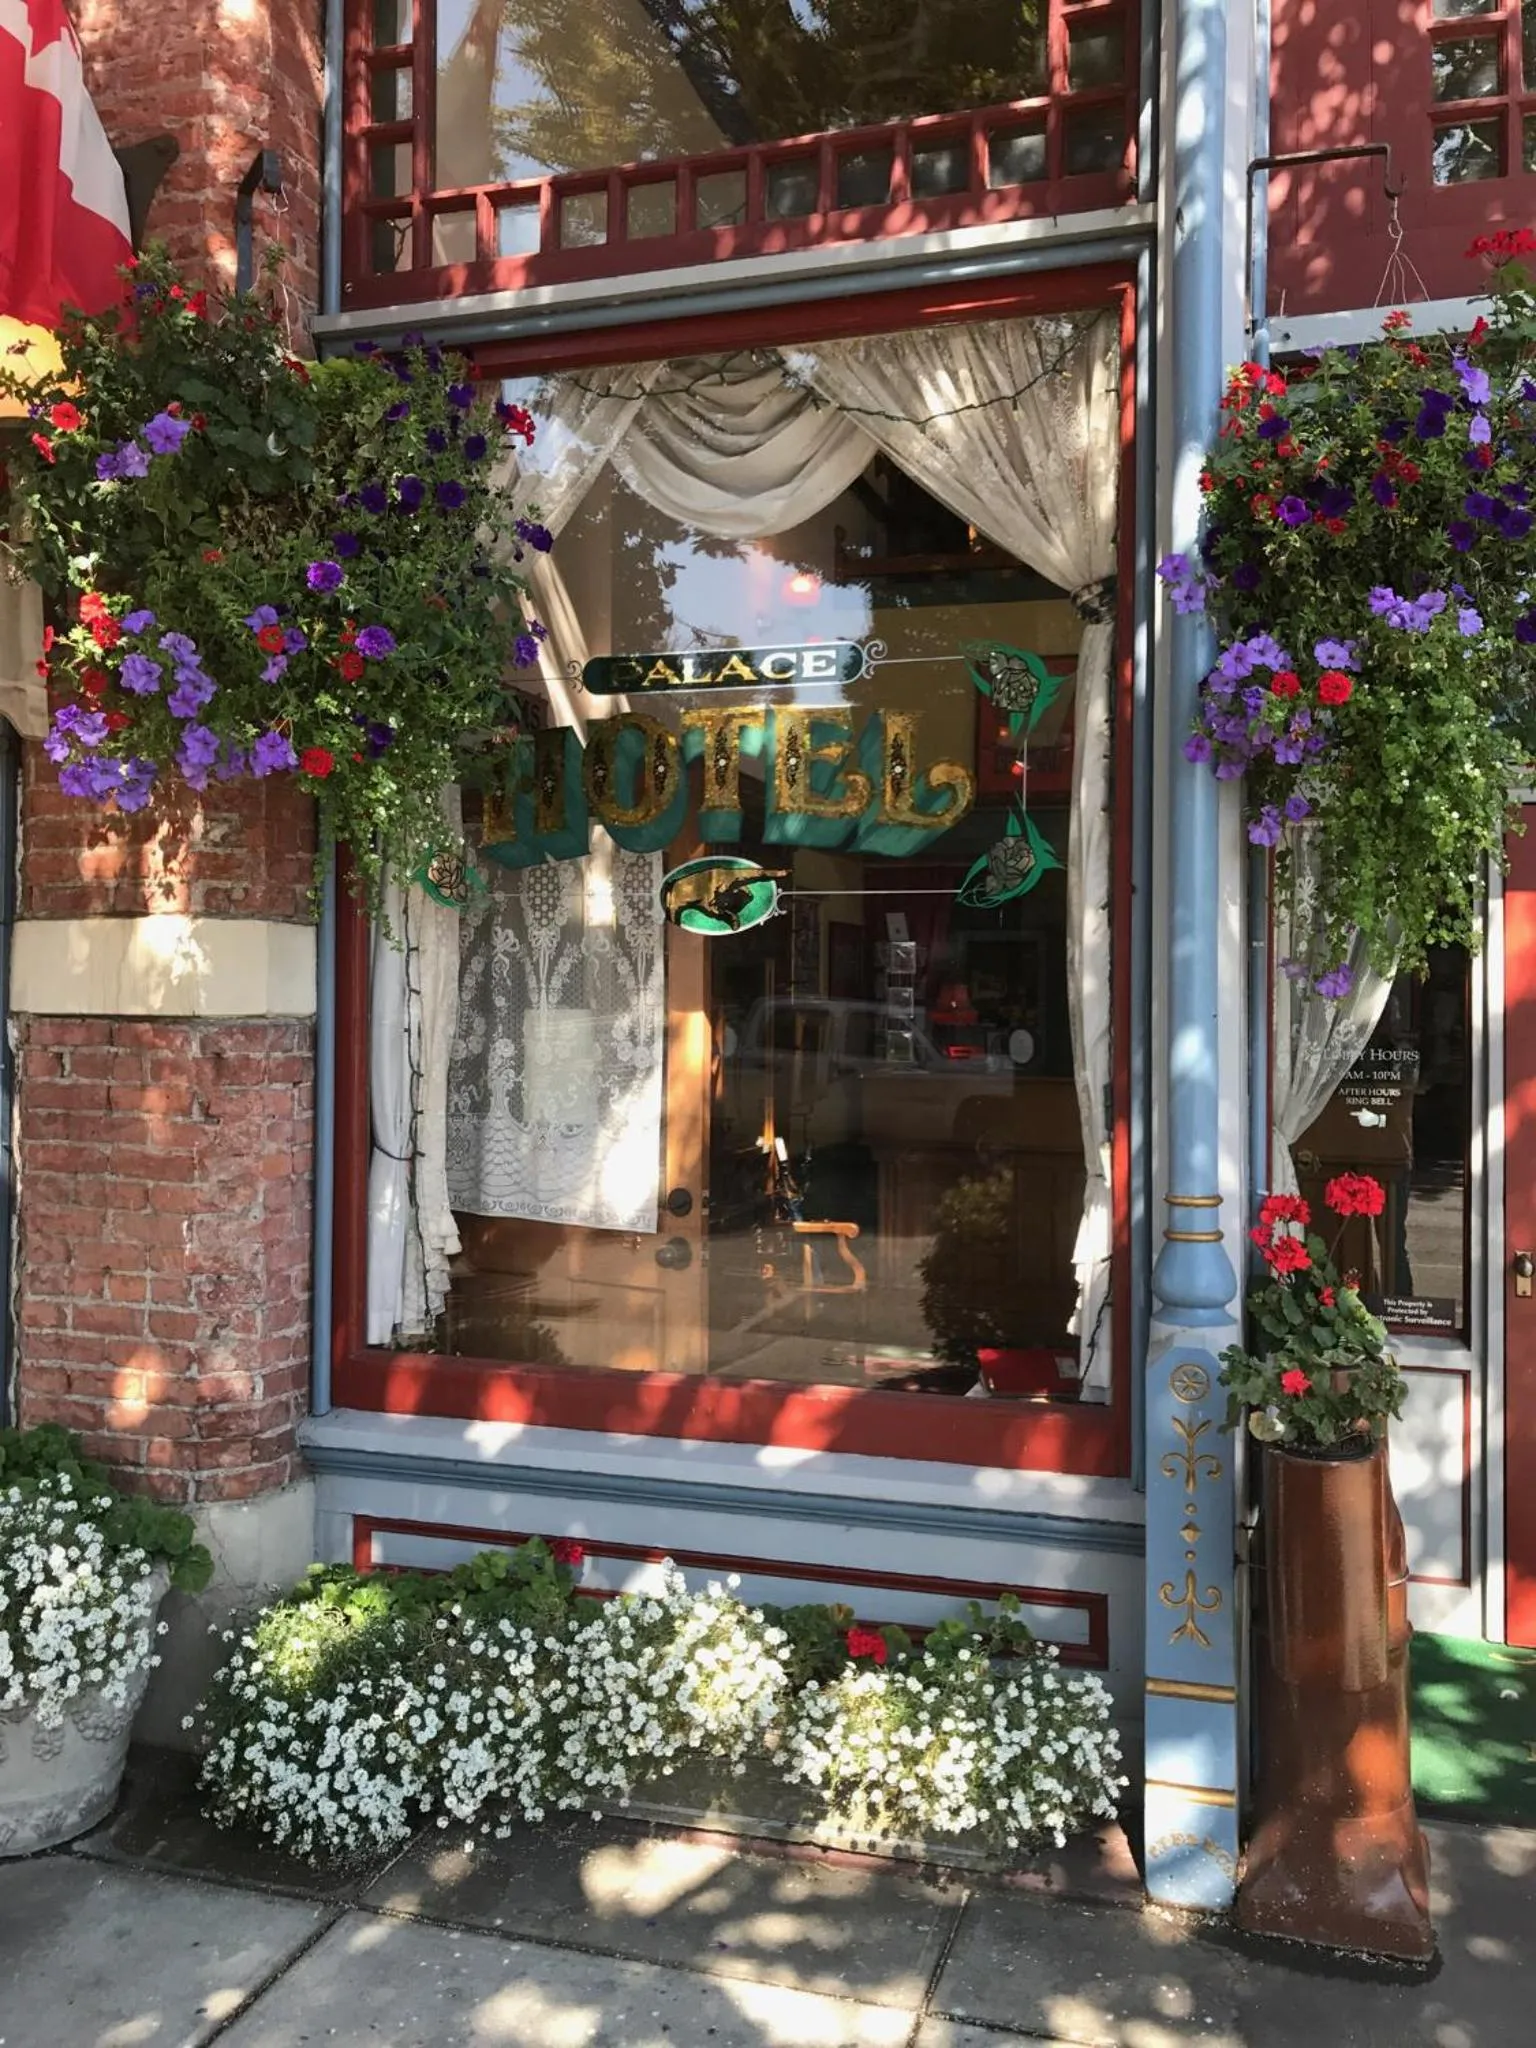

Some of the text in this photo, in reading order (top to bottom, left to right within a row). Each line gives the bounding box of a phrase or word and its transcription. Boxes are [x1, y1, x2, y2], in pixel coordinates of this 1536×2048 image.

[612, 650, 837, 688] PALACE
[478, 703, 979, 860] HOTEL
[1338, 1071, 1364, 1080] AM
[1372, 1071, 1401, 1081] 10PM
[1338, 1088, 1401, 1097] AFTER HOURS
[1345, 1097, 1394, 1106] RING BELL
[1397, 1300, 1425, 1309] Property
[1387, 1307, 1428, 1317] Protected by
[1404, 1316, 1452, 1326] Surveillance
